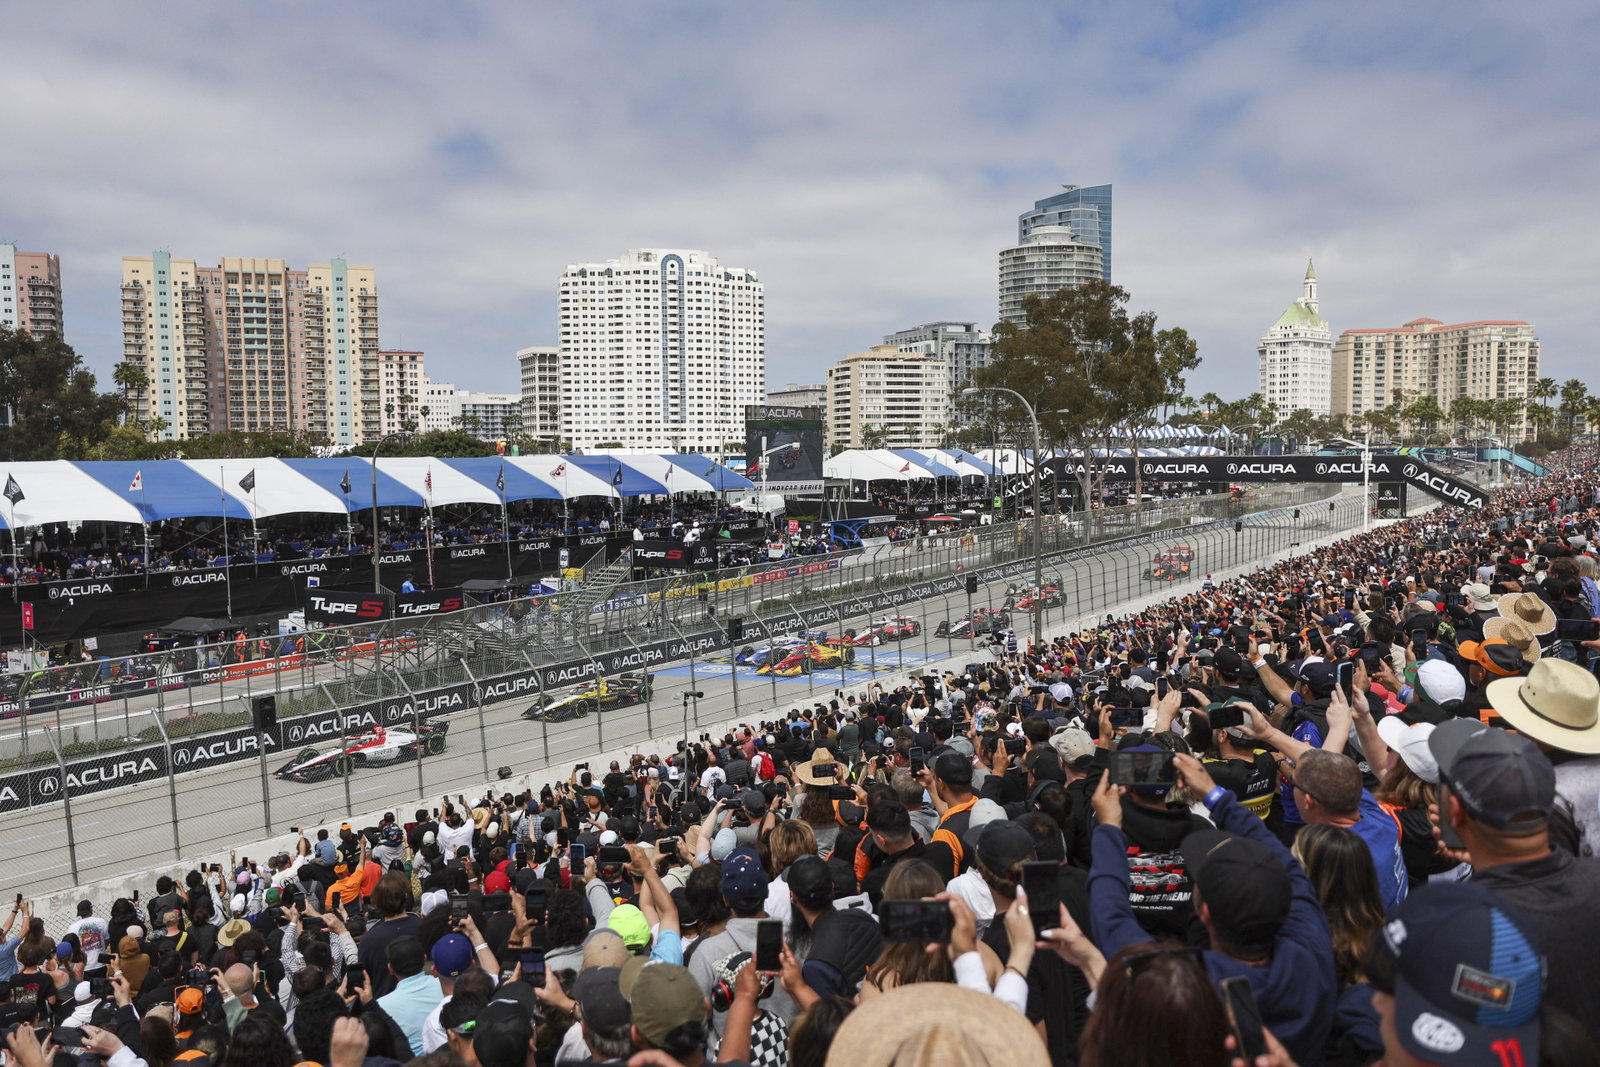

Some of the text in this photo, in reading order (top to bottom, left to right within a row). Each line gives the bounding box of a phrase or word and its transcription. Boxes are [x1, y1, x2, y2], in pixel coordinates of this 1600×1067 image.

[768, 409, 803, 418] ACURA
[1154, 464, 1210, 474] ACURA
[1238, 464, 1297, 474] ACURA
[1328, 464, 1390, 474] ACURA
[1414, 472, 1483, 509] ACURA
[789, 522, 798, 530] 27
[525, 542, 550, 550] ACURA
[585, 536, 606, 545] ACURA
[379, 554, 412, 564] ACURA
[457, 548, 486, 558] ACURA
[634, 548, 684, 560] Type S
[290, 563, 328, 574] ACURA
[182, 572, 226, 585] ACURA
[60, 584, 112, 598] ACURA
[911, 586, 932, 599] ACURA
[938, 582, 958, 592] ACURA
[310, 596, 384, 618] Type S
[399, 598, 462, 614] Type S
[848, 600, 874, 614] ACURA
[812, 608, 840, 622] ACURA
[772, 618, 803, 633] ACURA
[678, 638, 716, 654] ACURA
[622, 649, 664, 668] ACURA
[558, 662, 605, 682] ACURA
[143, 676, 184, 690] JOURNIE
[484, 676, 538, 698] ACURA
[66, 688, 110, 702] JOURNIE
[401, 693, 463, 718] ACURA
[304, 711, 376, 738] ACURA
[192, 732, 276, 763] ACURA
[60, 757, 158, 792] ACURA
[1490, 1038, 1526, 1067] 11
